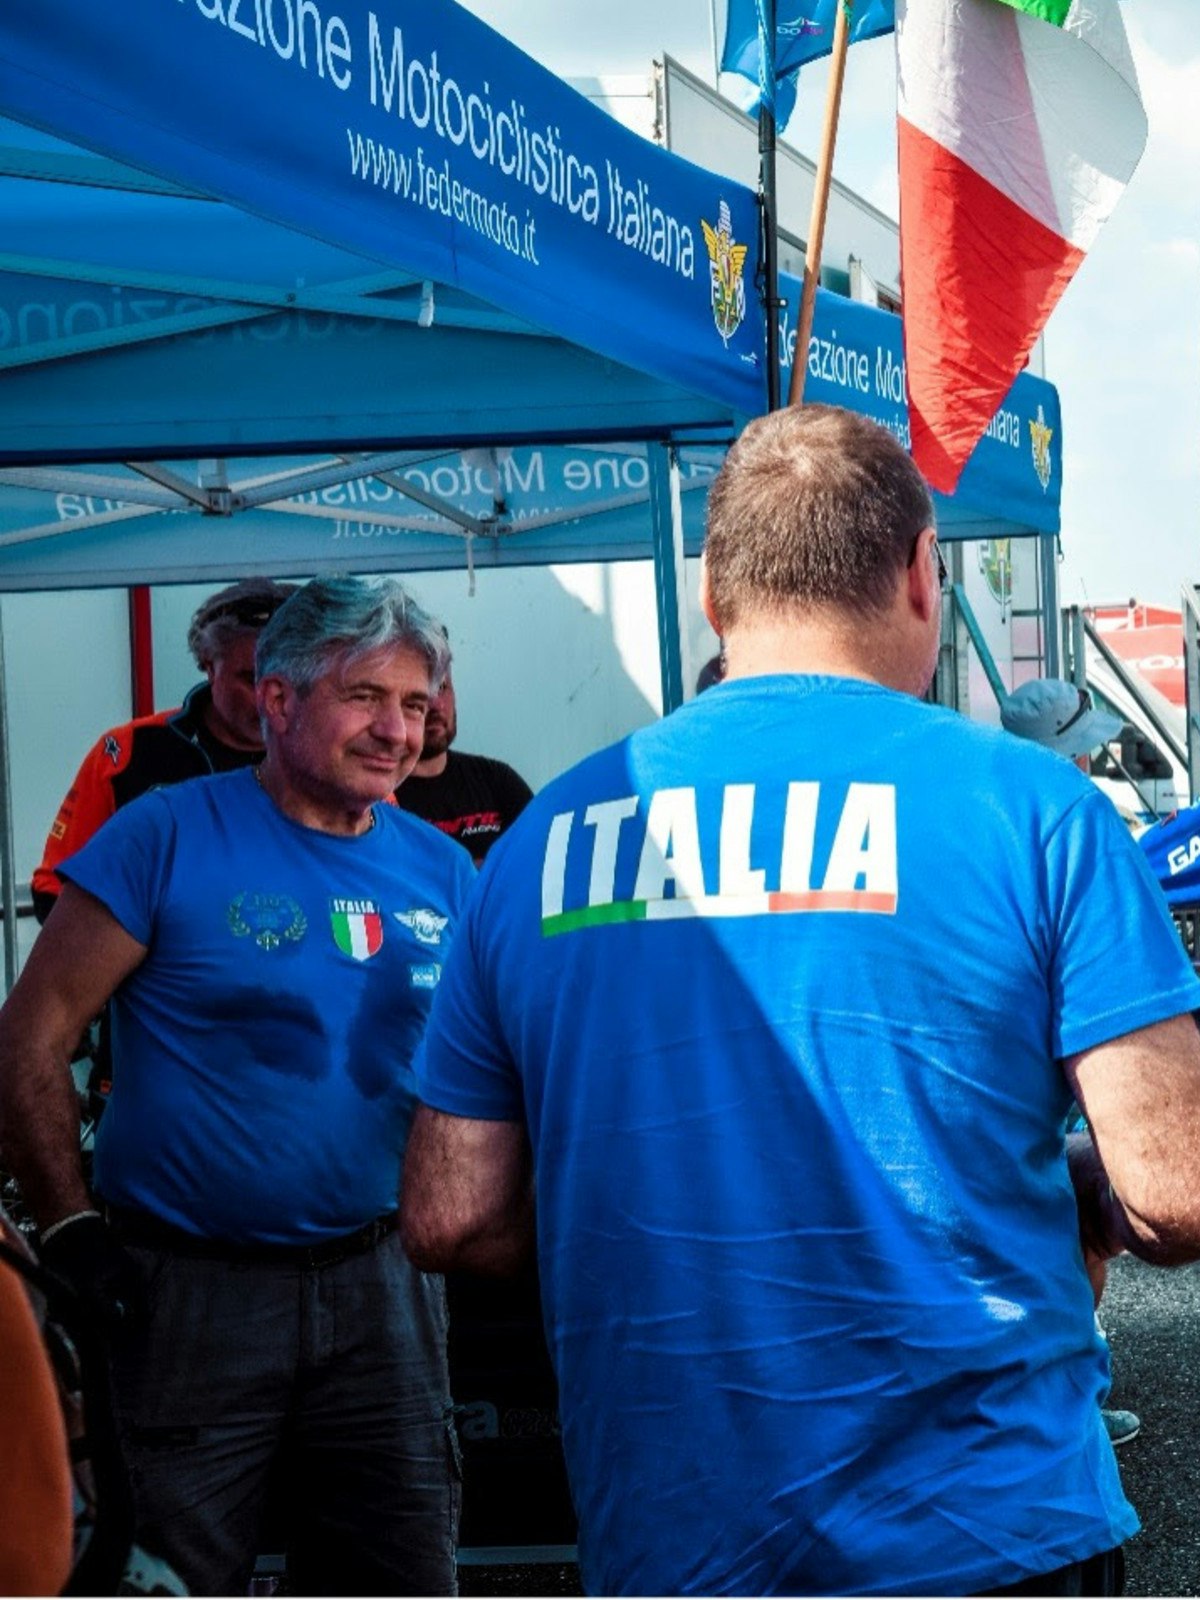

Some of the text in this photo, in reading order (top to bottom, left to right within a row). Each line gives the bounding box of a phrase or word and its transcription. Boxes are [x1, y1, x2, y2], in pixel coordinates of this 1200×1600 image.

[347, 128, 540, 266] www.federmoto.it
[369, 11, 600, 226] Motociclistica
[606, 160, 694, 279] Italiana
[334, 899, 376, 914] ITALIA
[541, 781, 898, 919] ITALIA
